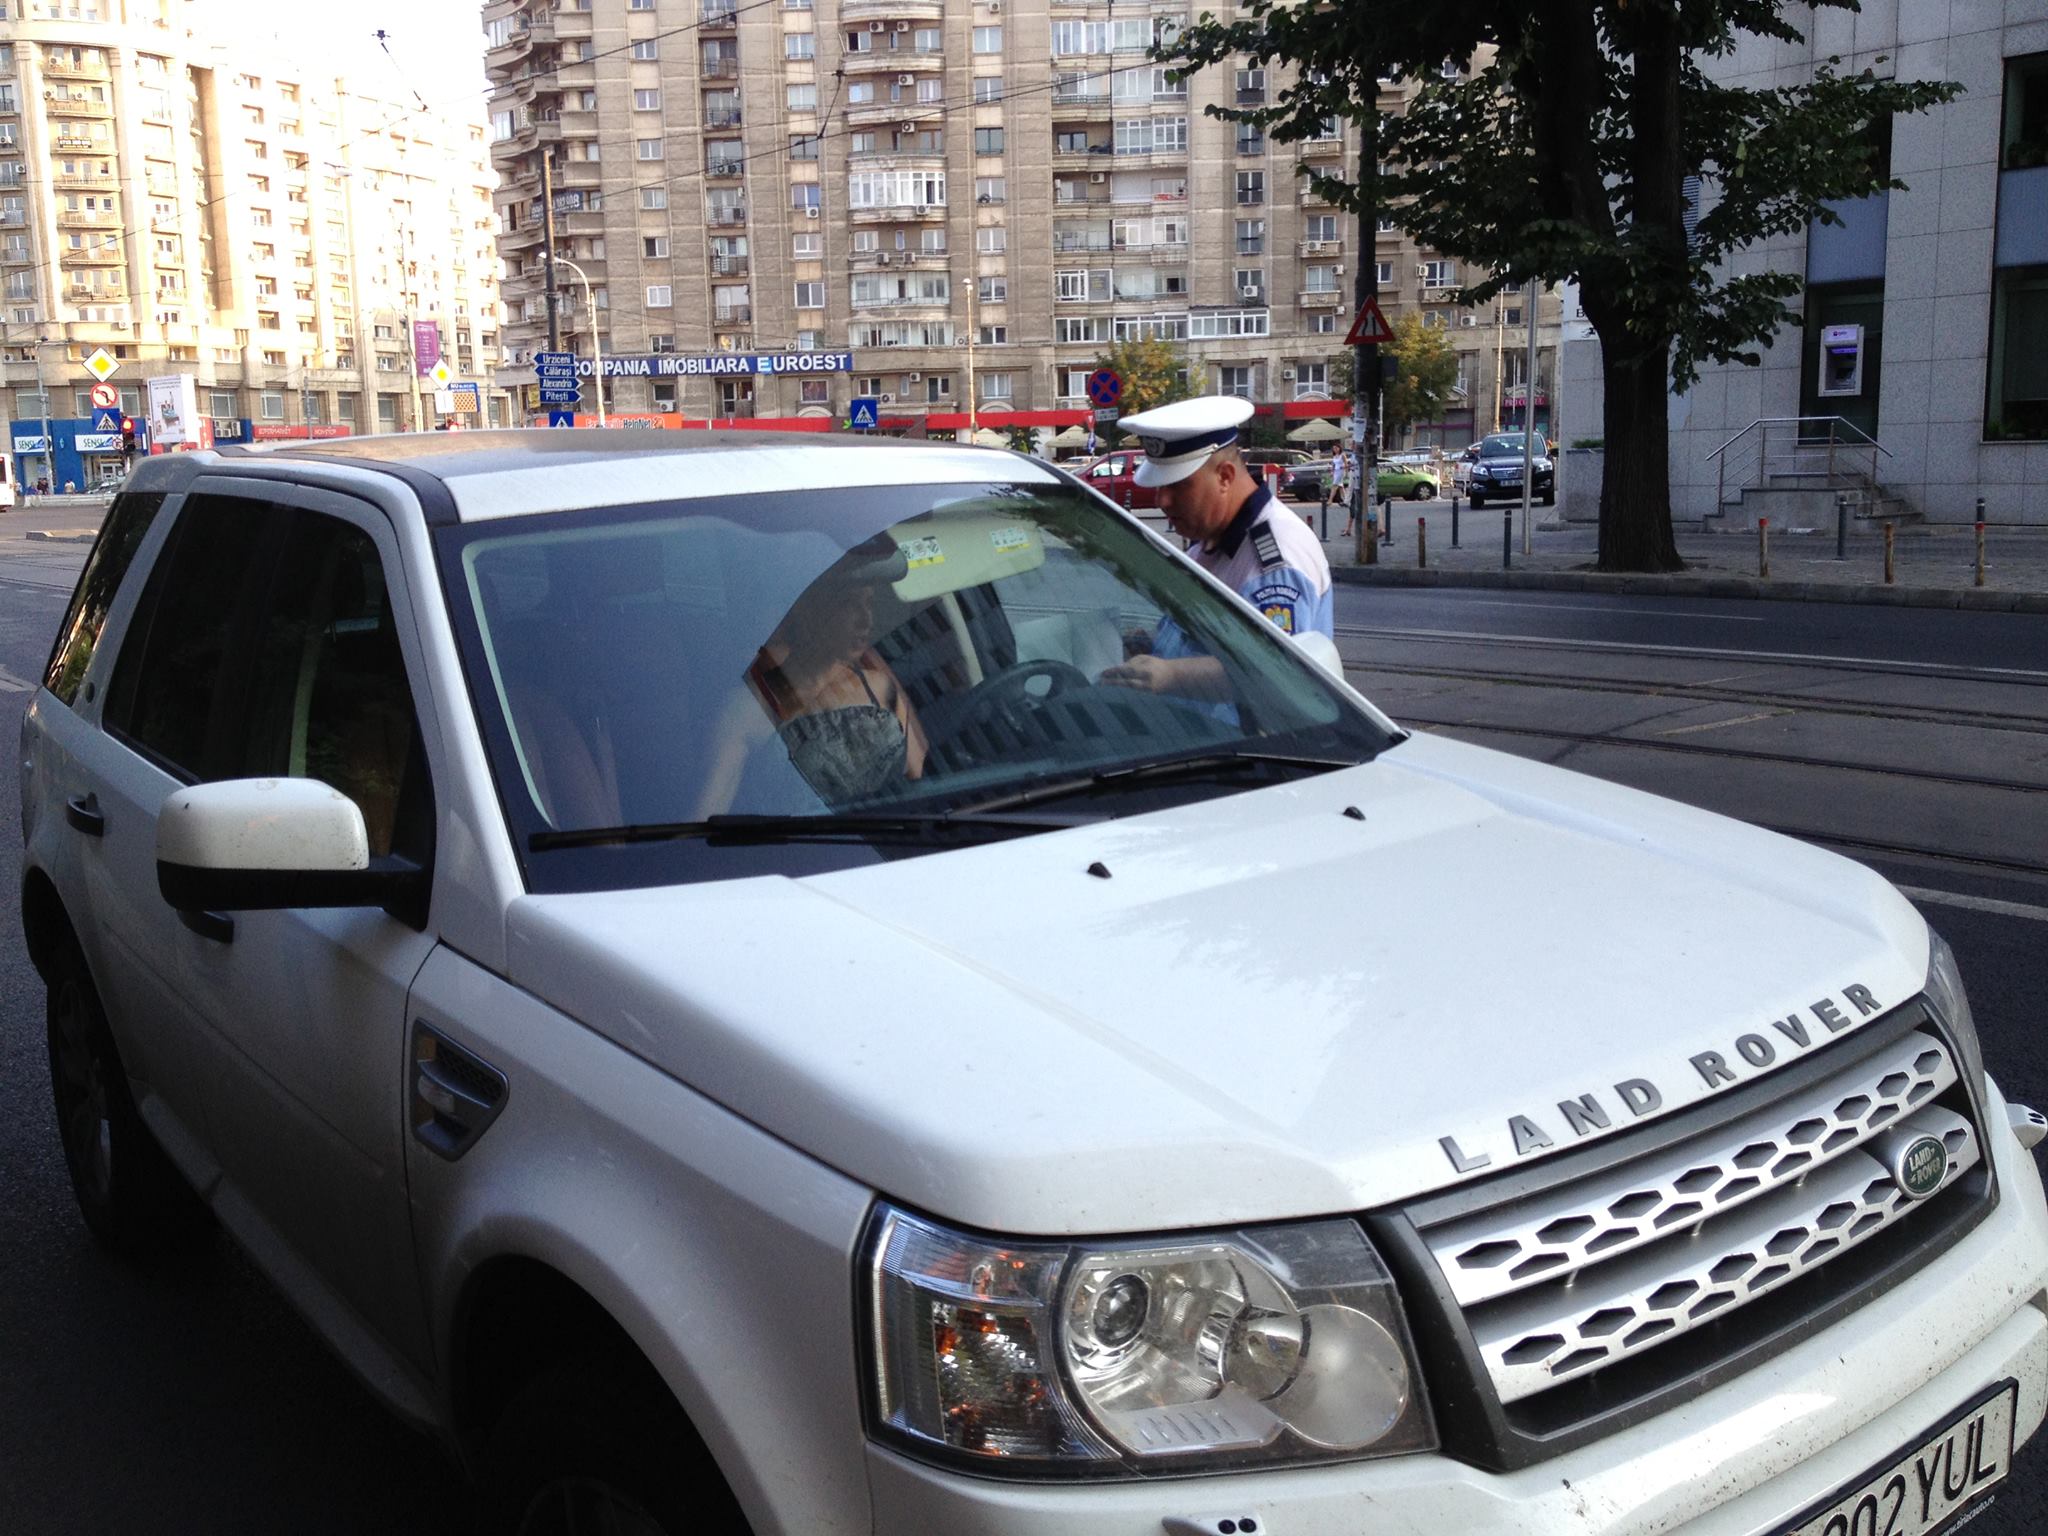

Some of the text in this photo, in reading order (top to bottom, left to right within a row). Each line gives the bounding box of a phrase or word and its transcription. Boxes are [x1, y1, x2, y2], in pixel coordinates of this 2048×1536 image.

[542, 354, 571, 364] Urziceni
[658, 357, 749, 375] IMOBILIARA
[757, 354, 848, 374] EUROEST
[1439, 983, 1882, 1174] LAND ROVER
[1909, 1146, 1932, 1172] LAND
[1917, 1157, 1941, 1184] ROVER
[1915, 1413, 1997, 1503] YUL
